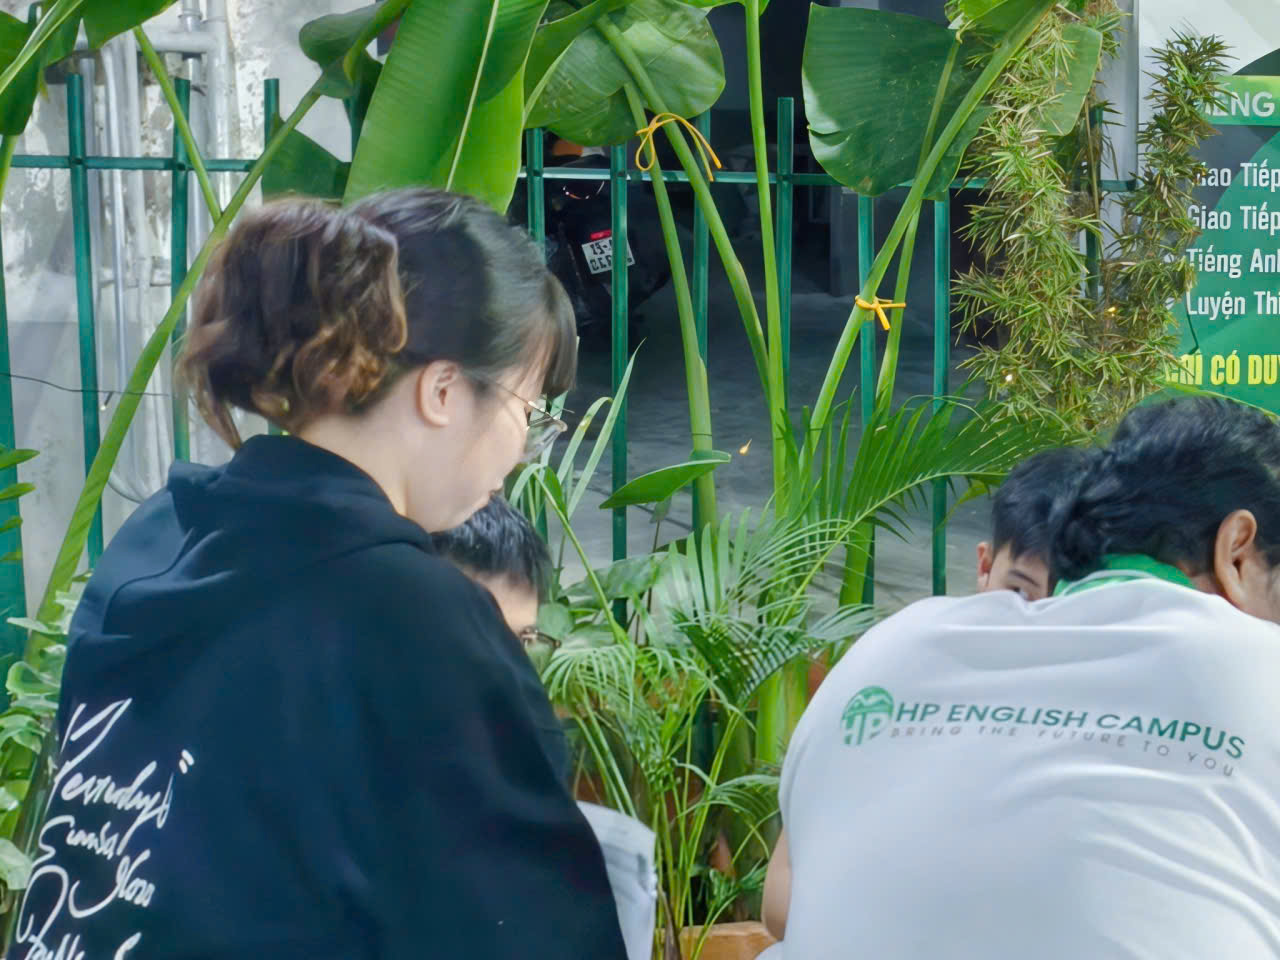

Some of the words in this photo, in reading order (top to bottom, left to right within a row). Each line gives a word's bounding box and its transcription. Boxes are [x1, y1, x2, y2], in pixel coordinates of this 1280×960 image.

[1186, 204, 1232, 230] Giao
[1210, 349, 1241, 386] CÓ
[895, 702, 941, 722] HP
[946, 704, 1089, 728] ENGLISH
[1096, 713, 1246, 759] CAMPUS
[1142, 740, 1170, 757] TO
[1187, 751, 1235, 777] YOU
